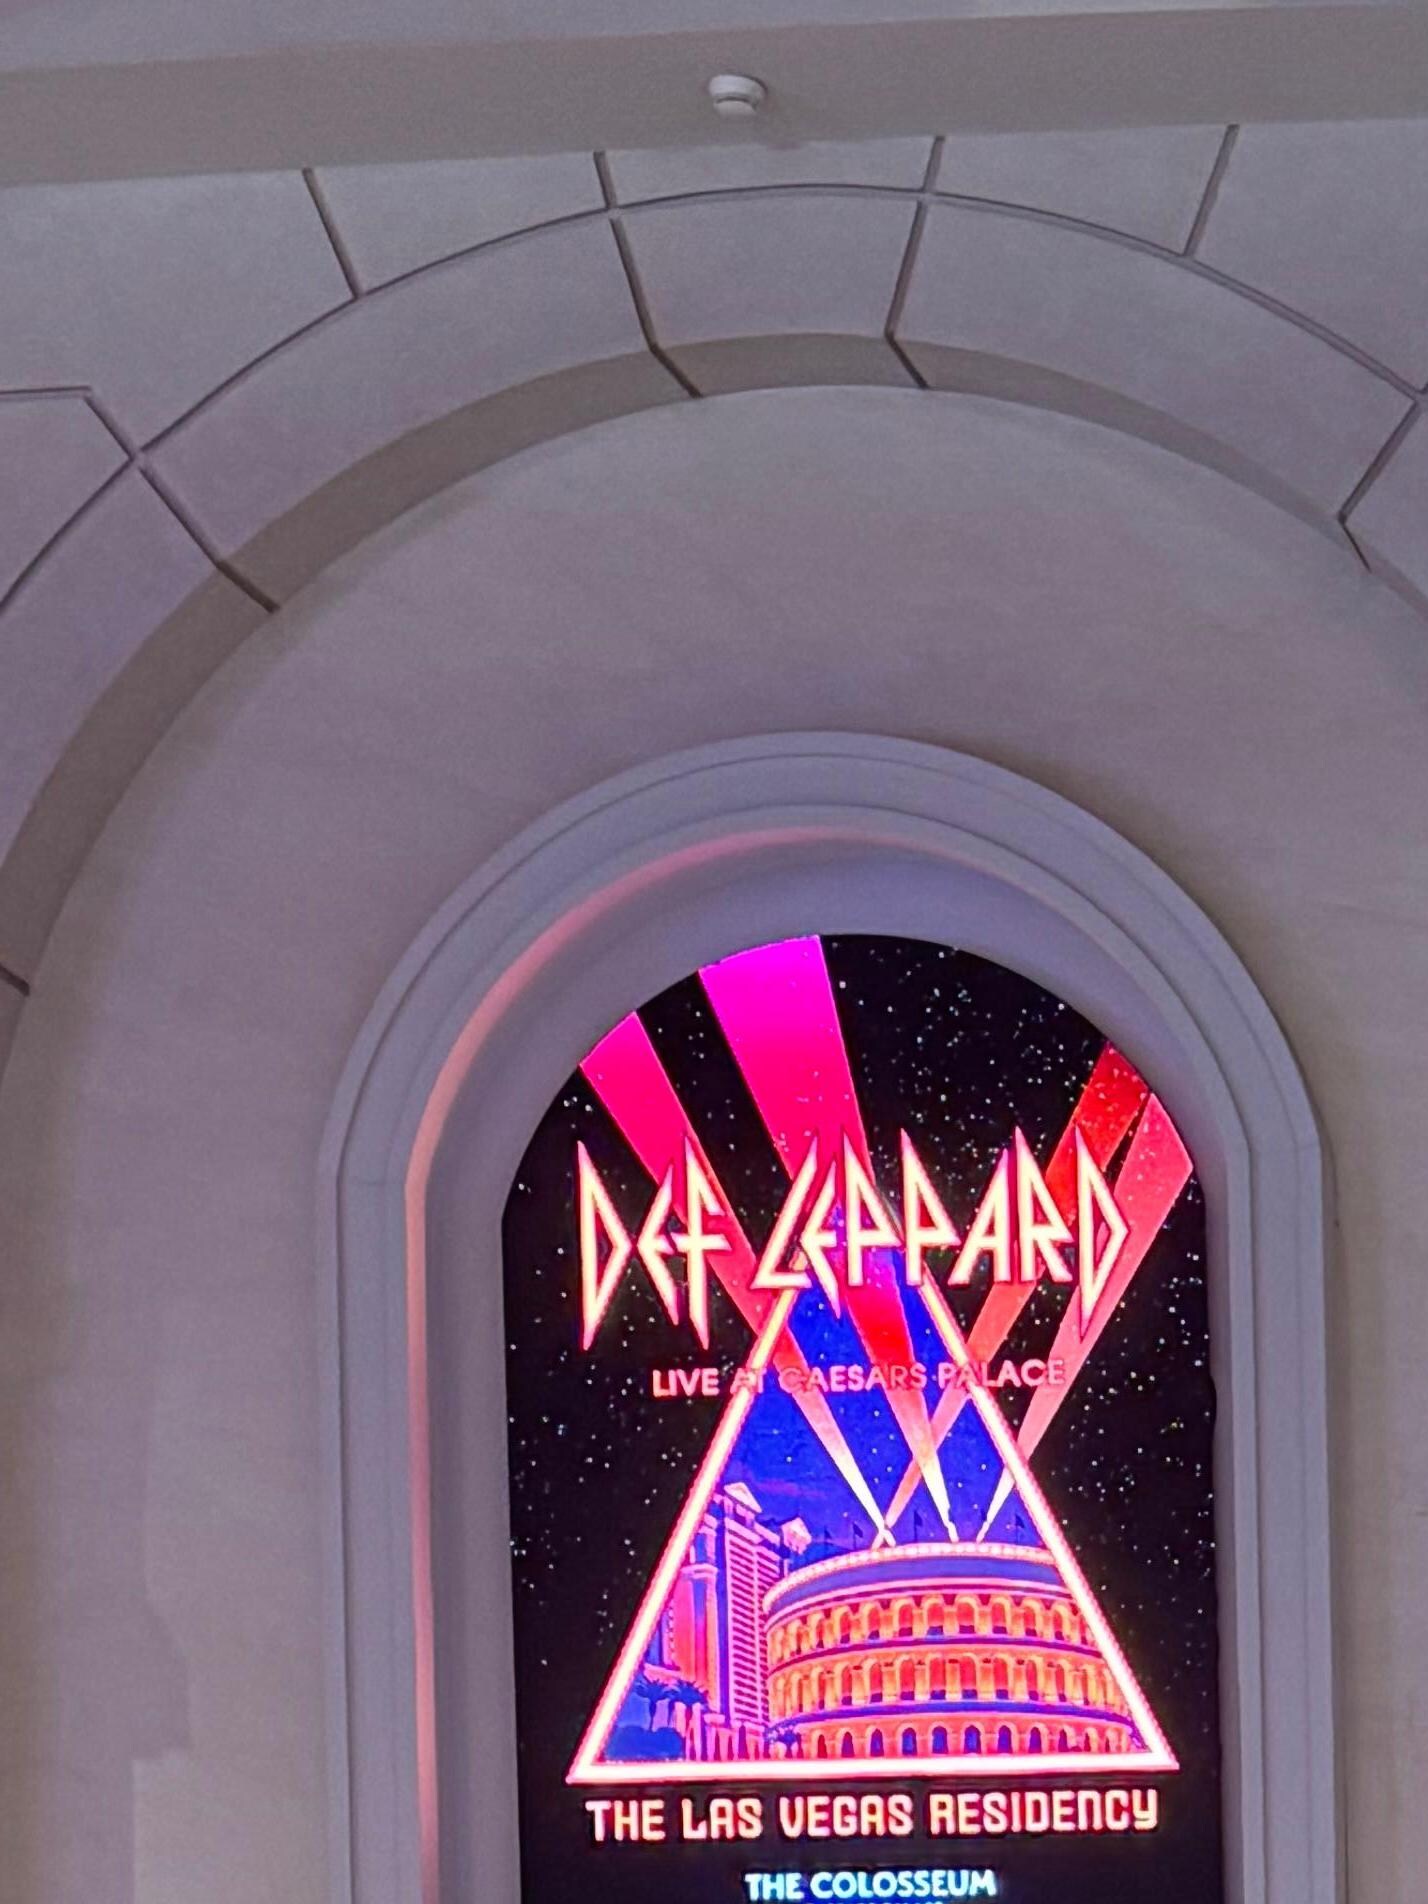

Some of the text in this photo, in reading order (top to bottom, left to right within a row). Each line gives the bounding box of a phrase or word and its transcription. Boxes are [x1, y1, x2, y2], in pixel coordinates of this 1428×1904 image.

[578, 1126, 1131, 1351] DEF LEPPARD
[652, 1360, 1065, 1397] LIVE AT CAESARS PALACE
[585, 1789, 1158, 1841] THE LAS VEGAS RESIDENCY
[745, 1869, 997, 1900] THE COLOSSEUM
